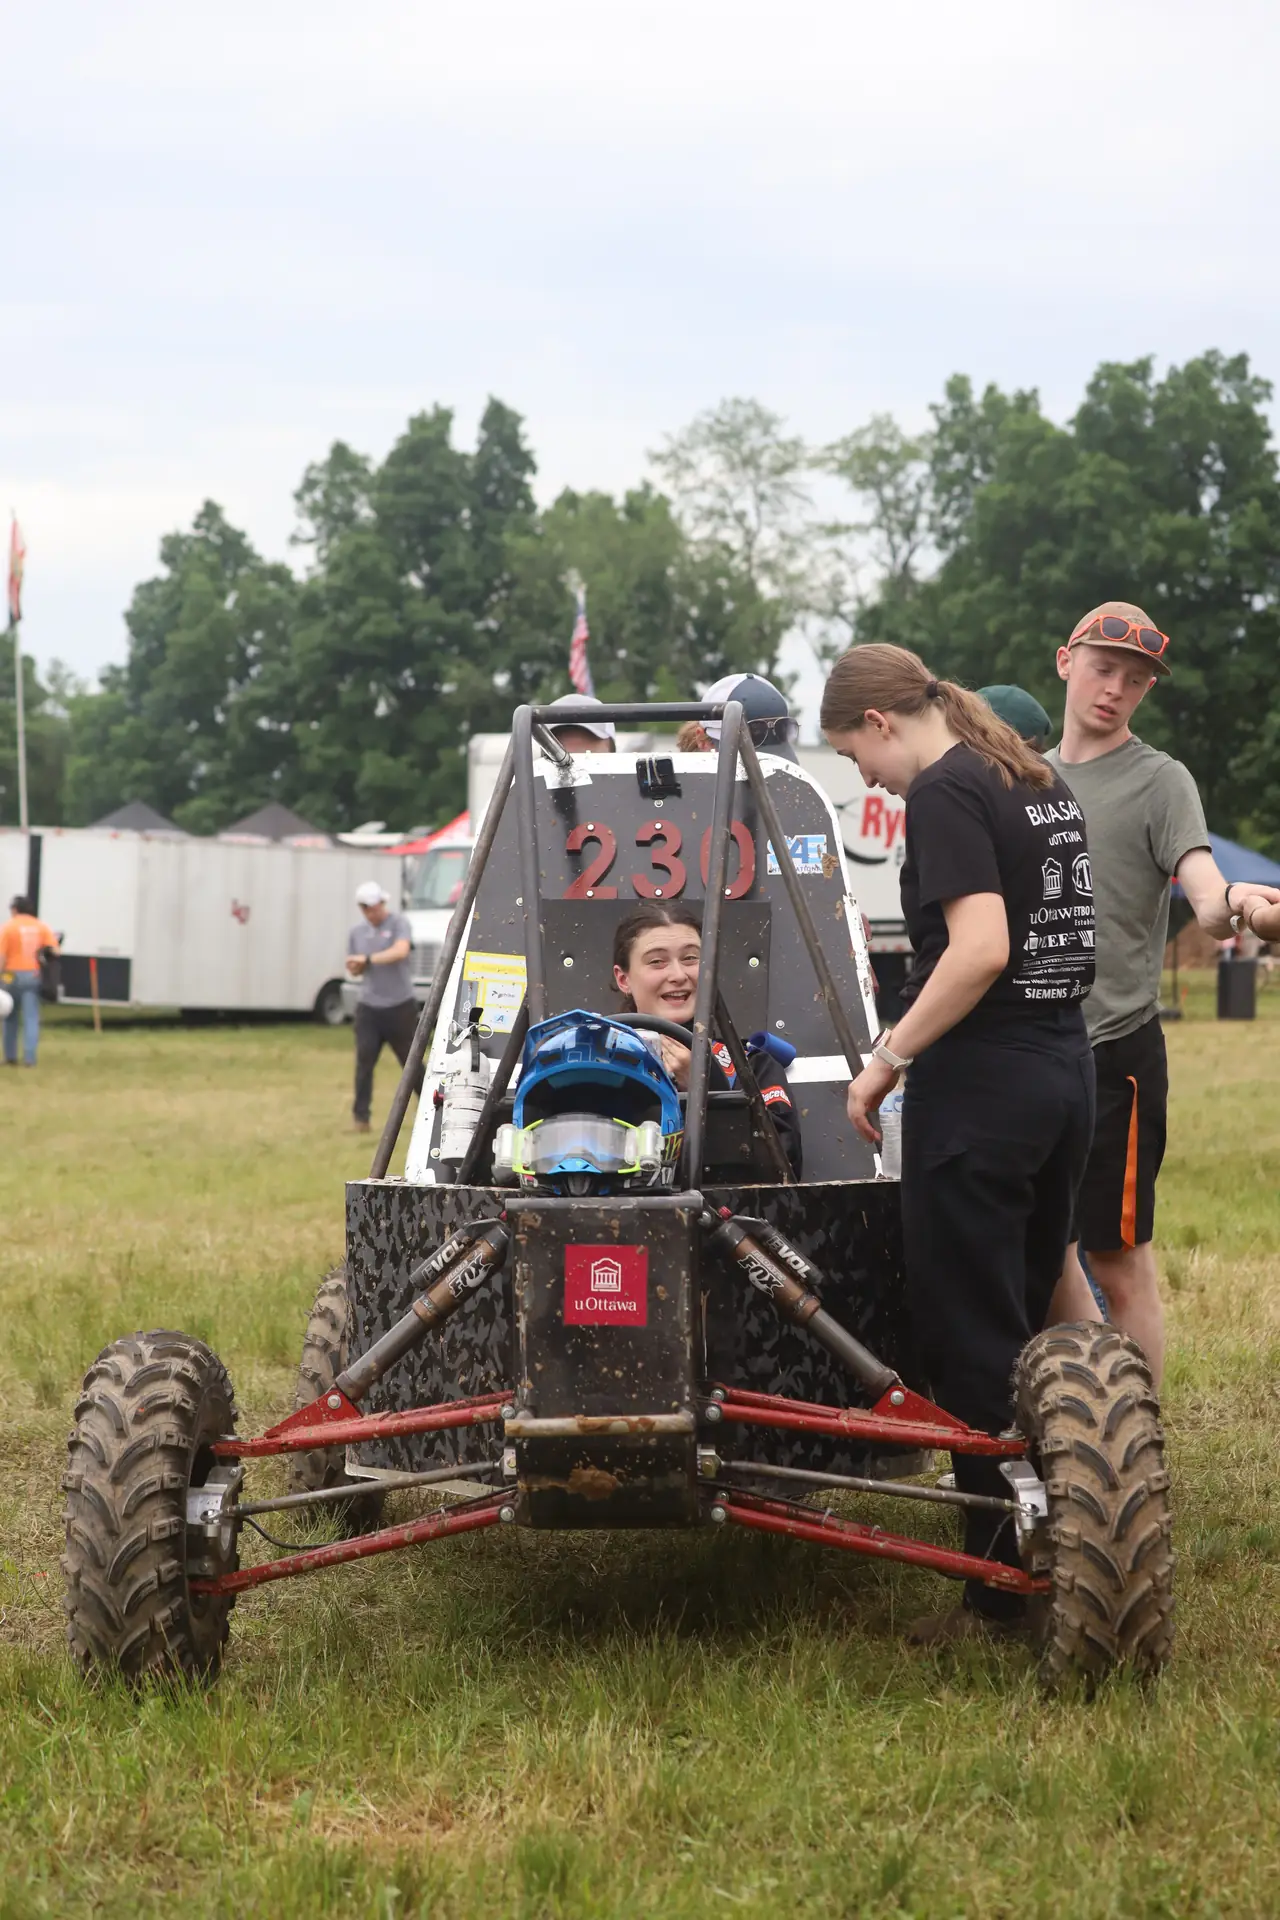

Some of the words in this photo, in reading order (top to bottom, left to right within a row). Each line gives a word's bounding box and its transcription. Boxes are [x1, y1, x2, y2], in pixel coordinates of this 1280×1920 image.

[562, 820, 755, 899] 230
[1025, 988, 1067, 999] SIEMENS
[449, 1253, 494, 1298] FOX
[737, 1254, 785, 1298] FOX
[766, 1236, 811, 1279] EVOL
[574, 1297, 637, 1312] uOttawa
